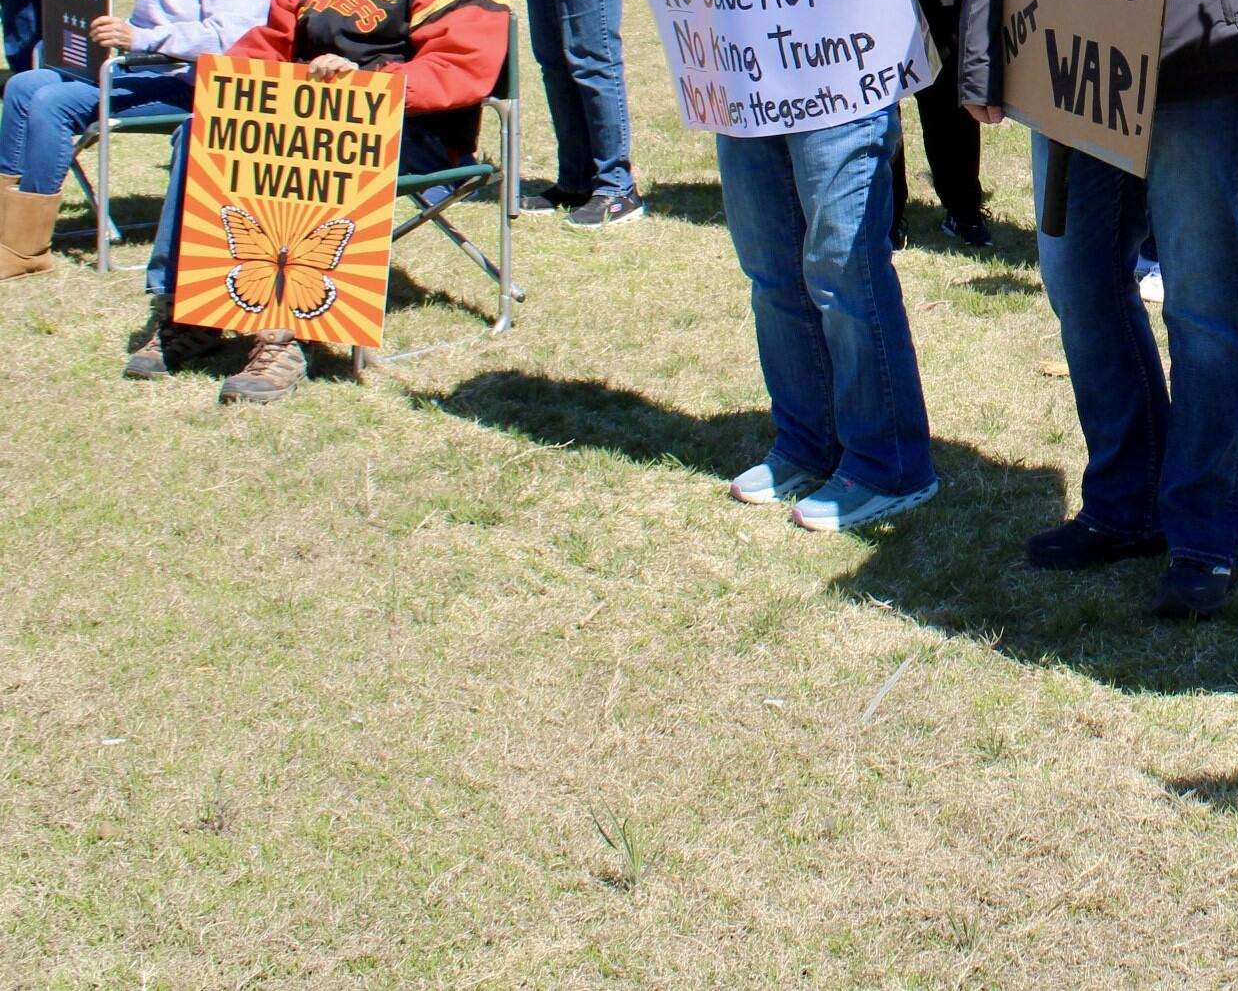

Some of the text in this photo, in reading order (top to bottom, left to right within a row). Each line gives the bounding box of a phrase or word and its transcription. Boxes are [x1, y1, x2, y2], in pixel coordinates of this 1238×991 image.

[767, 24, 876, 71] Trump
[1002, 0, 1038, 65] NOT
[213, 76, 387, 125] THE ONLY
[706, 80, 748, 129] Miller,
[750, 86, 858, 129] Hegseth,
[859, 59, 921, 105] RFK
[1045, 29, 1149, 137] WAR!
[208, 116, 382, 168] MONARCH
[230, 159, 353, 205] I WANT
